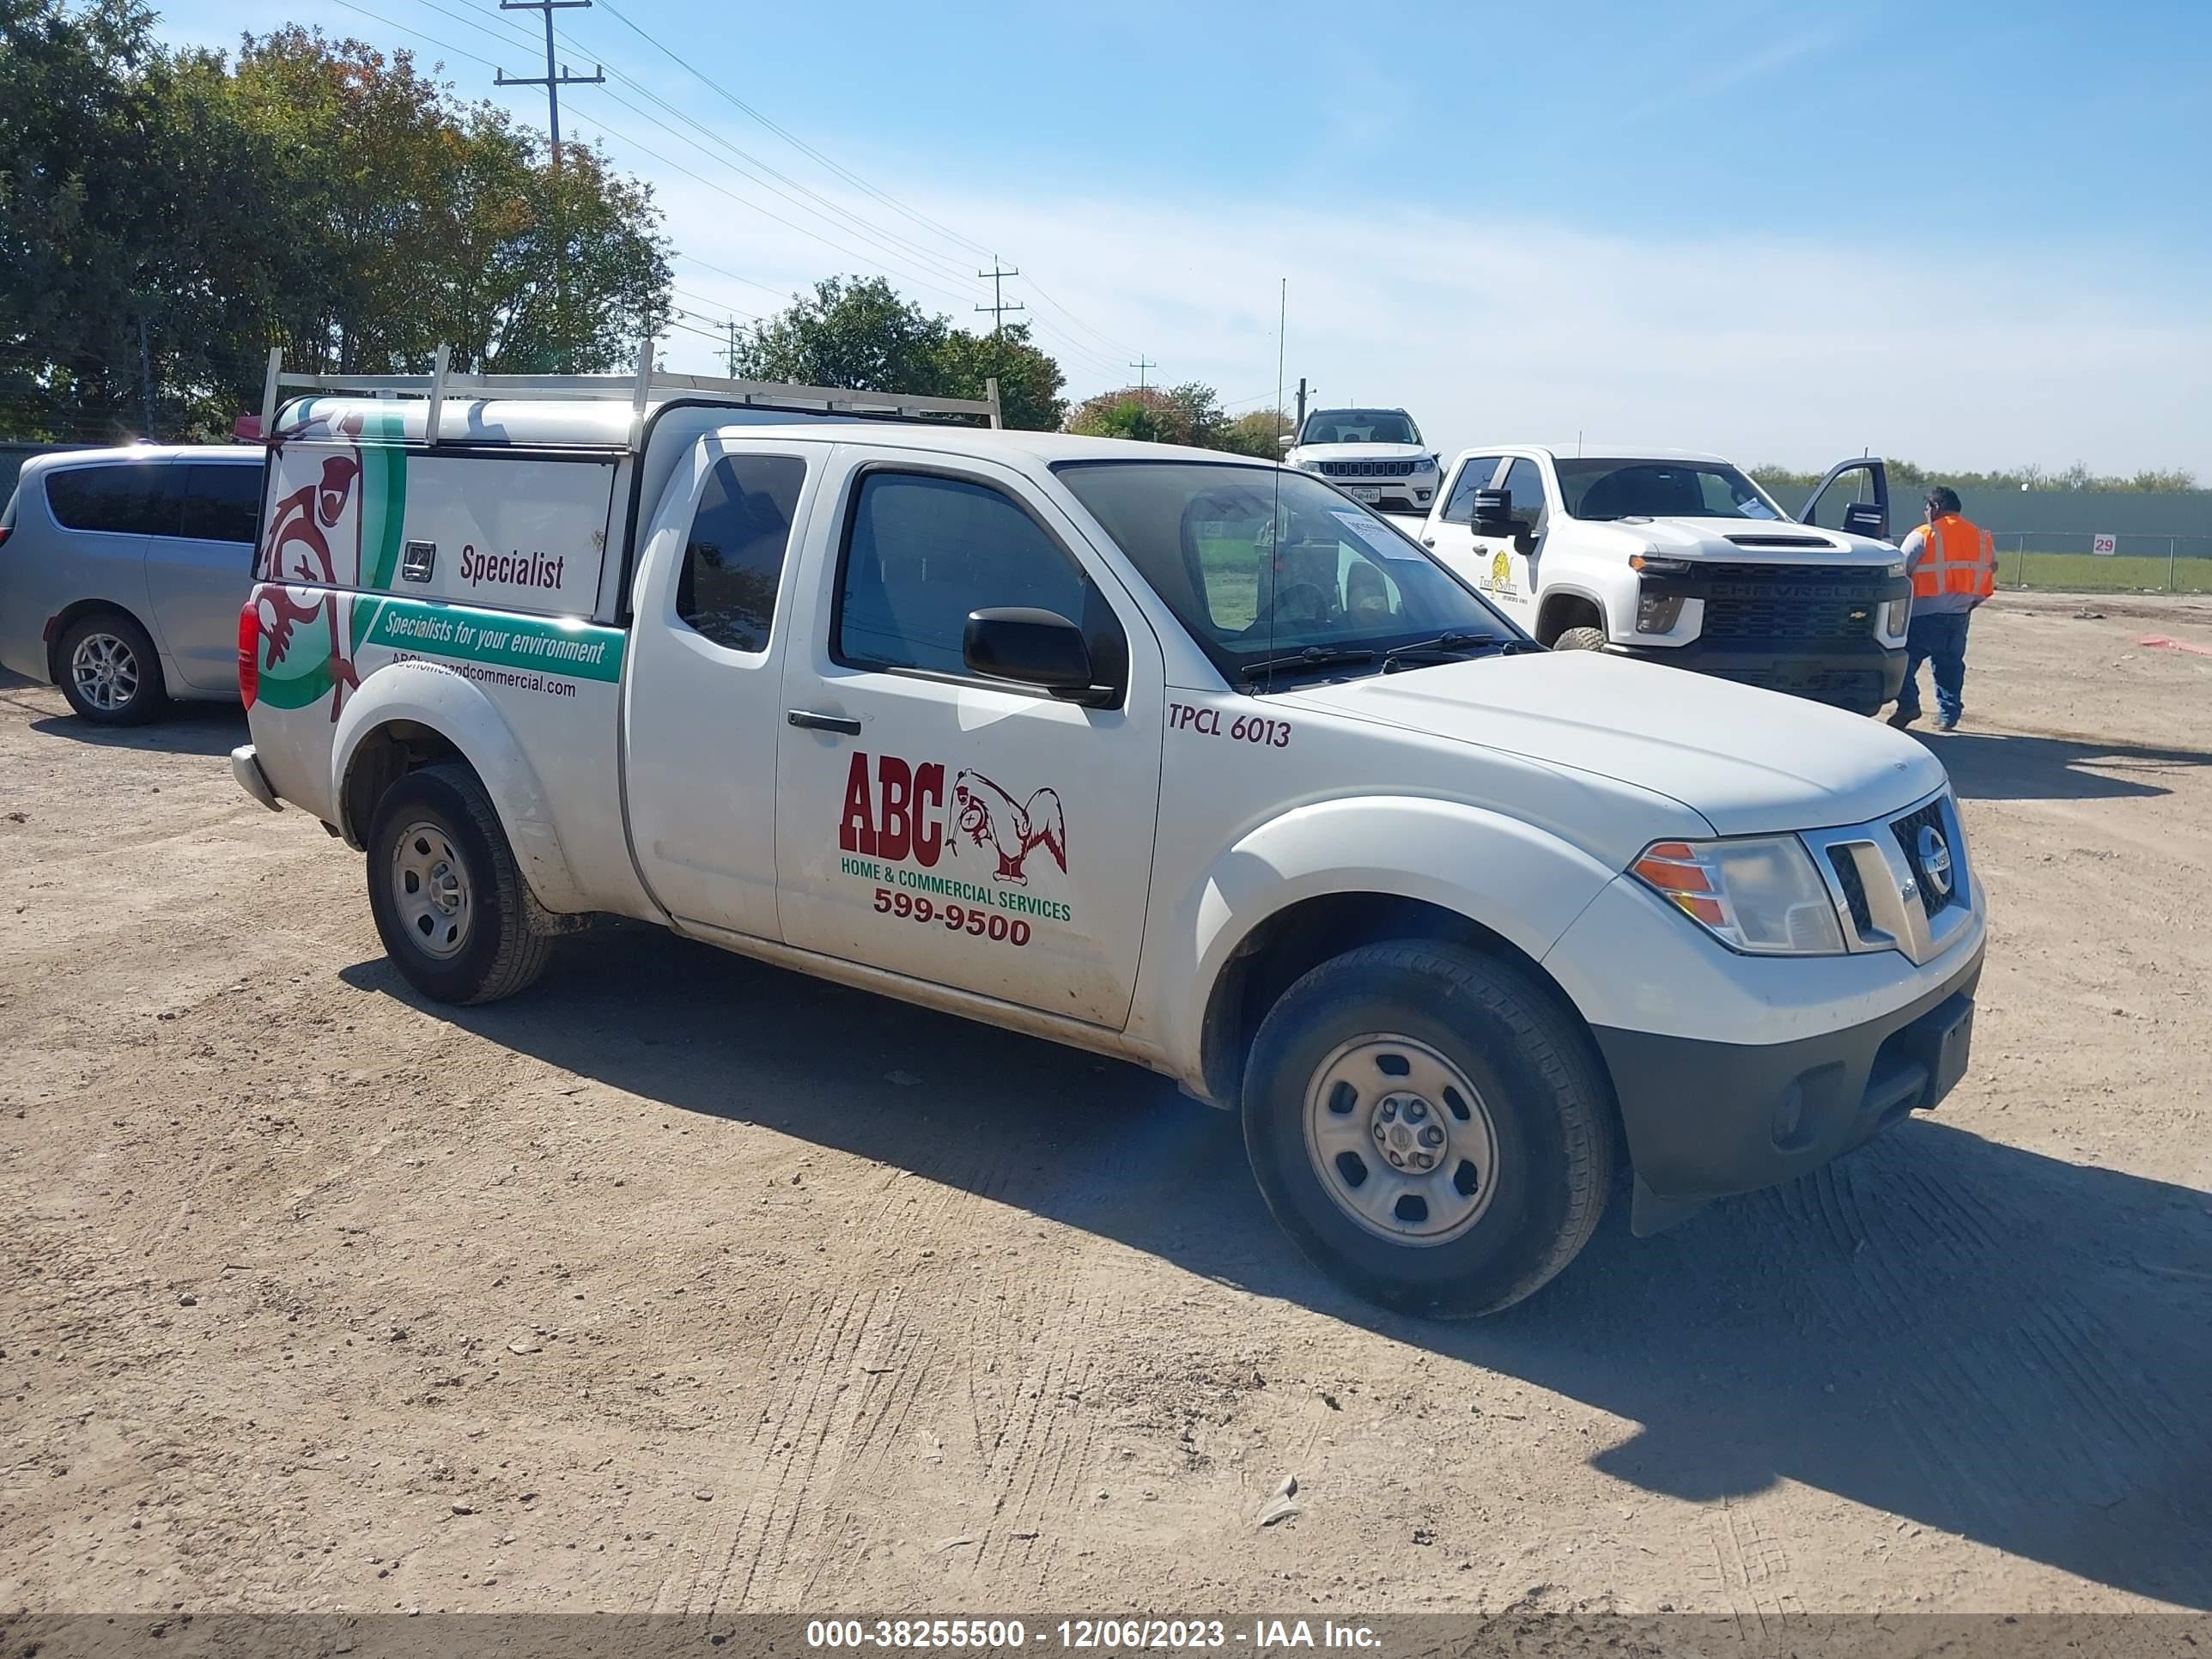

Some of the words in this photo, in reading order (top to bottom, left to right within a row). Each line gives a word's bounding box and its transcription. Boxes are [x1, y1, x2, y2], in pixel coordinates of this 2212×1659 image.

[460, 544, 563, 589] Specialist
[2095, 539, 2113, 551] 29
[1711, 584, 1883, 599] CHEVROLET
[386, 611, 453, 641] Specialists
[454, 621, 474, 645] for
[475, 629, 509, 651] your
[511, 632, 605, 665] environment
[1170, 703, 1221, 736] TPCL
[1231, 715, 1291, 748] 6013
[839, 751, 945, 867] ABC
[842, 857, 881, 880] HOME
[884, 866, 895, 884] &
[899, 870, 994, 905] COMMERCIAL
[999, 891, 1072, 921] SERVICES
[873, 887, 1031, 946] 599-9500
